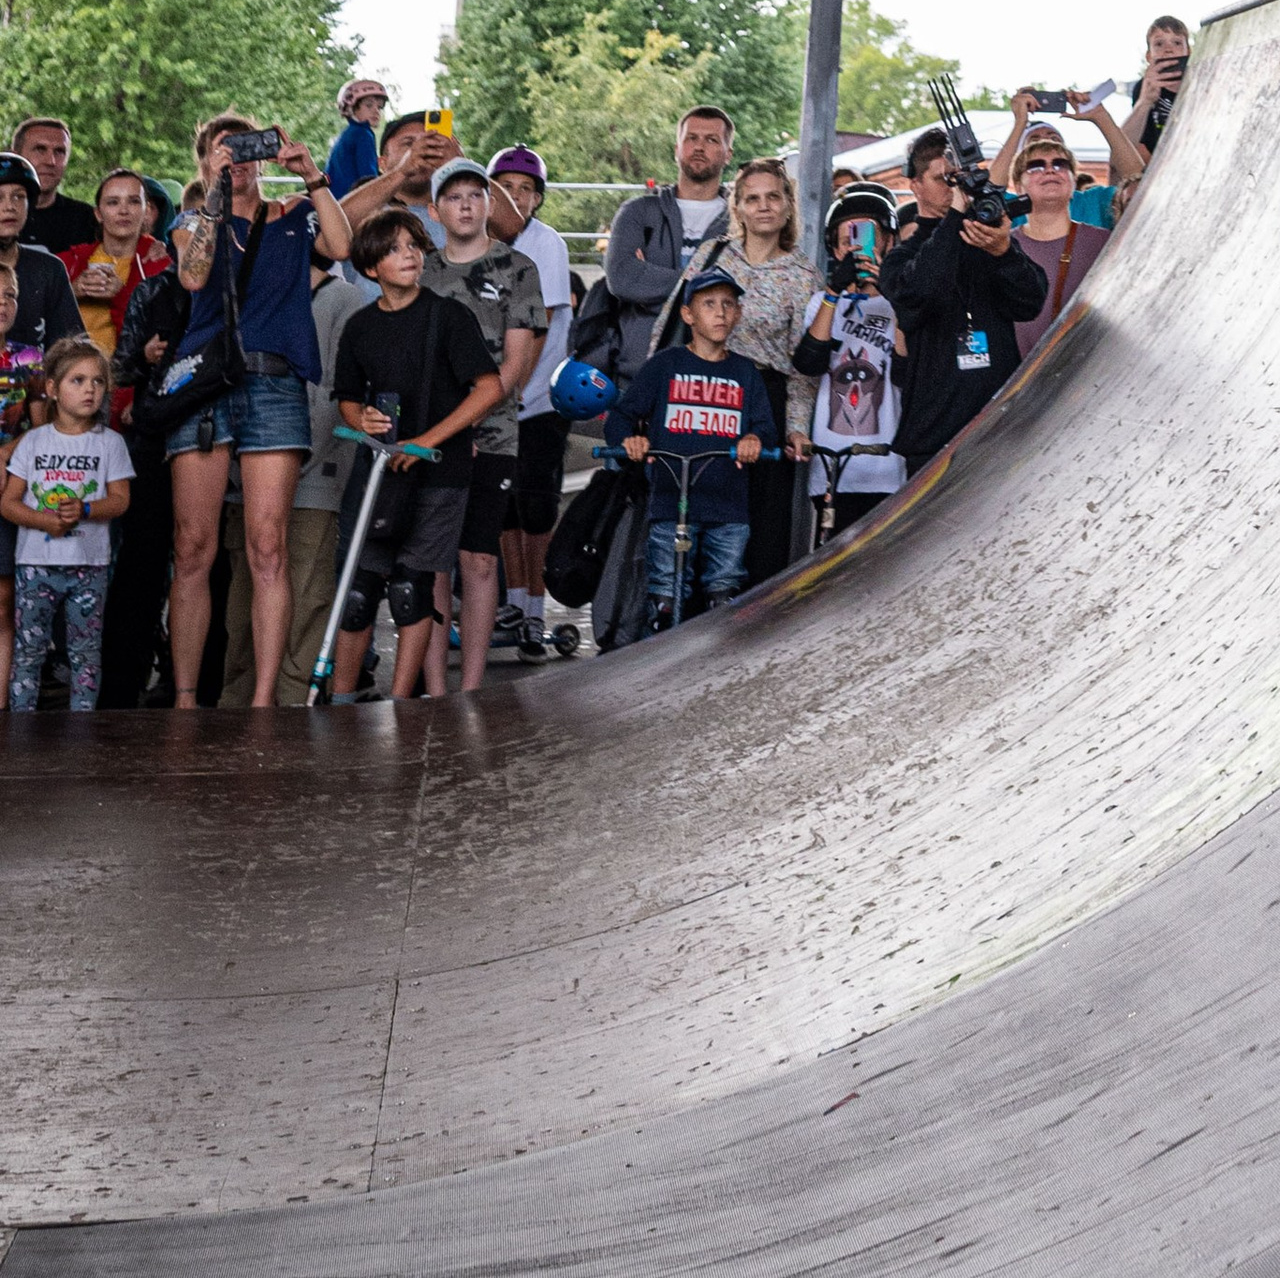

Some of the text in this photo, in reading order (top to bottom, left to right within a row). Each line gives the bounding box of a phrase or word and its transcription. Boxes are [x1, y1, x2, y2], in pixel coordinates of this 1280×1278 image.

[672, 373, 740, 406] NEVER
[668, 409, 738, 439] GIVE UP
